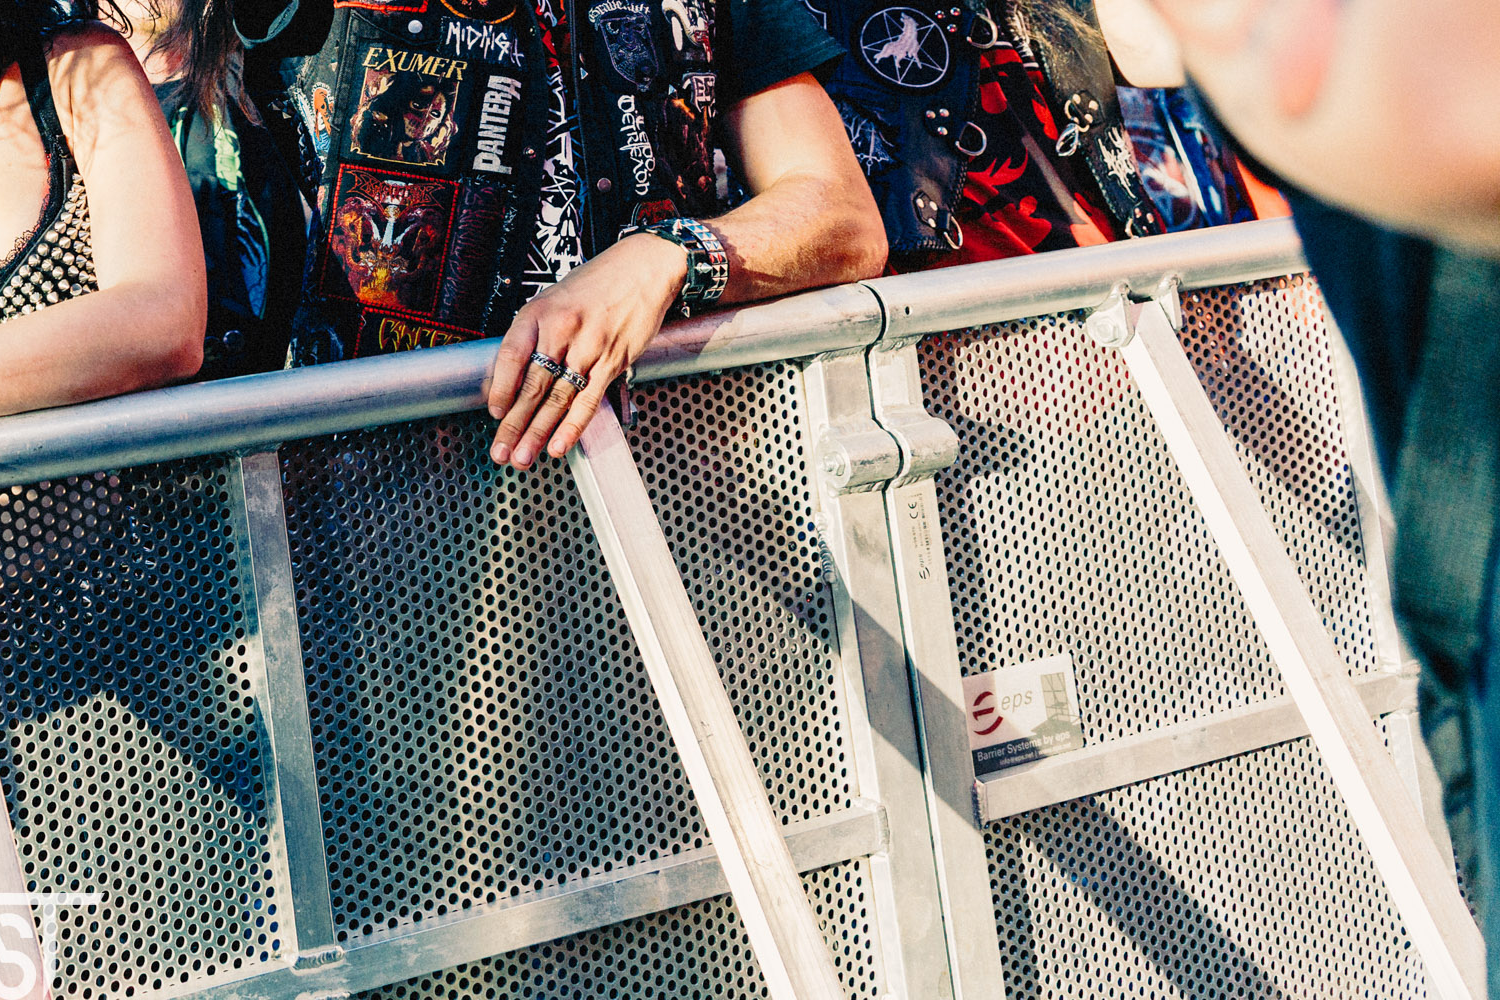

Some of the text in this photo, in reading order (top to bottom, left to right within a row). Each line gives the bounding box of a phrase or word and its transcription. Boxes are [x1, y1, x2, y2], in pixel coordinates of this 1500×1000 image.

[362, 46, 468, 81] EXUMER
[472, 74, 522, 175] PANTERA
[1001, 690, 1033, 714] eps
[977, 748, 1006, 762] Barrier
[1007, 737, 1042, 755] Systems
[1043, 733, 1054, 745] by
[1055, 731, 1071, 743] eps
